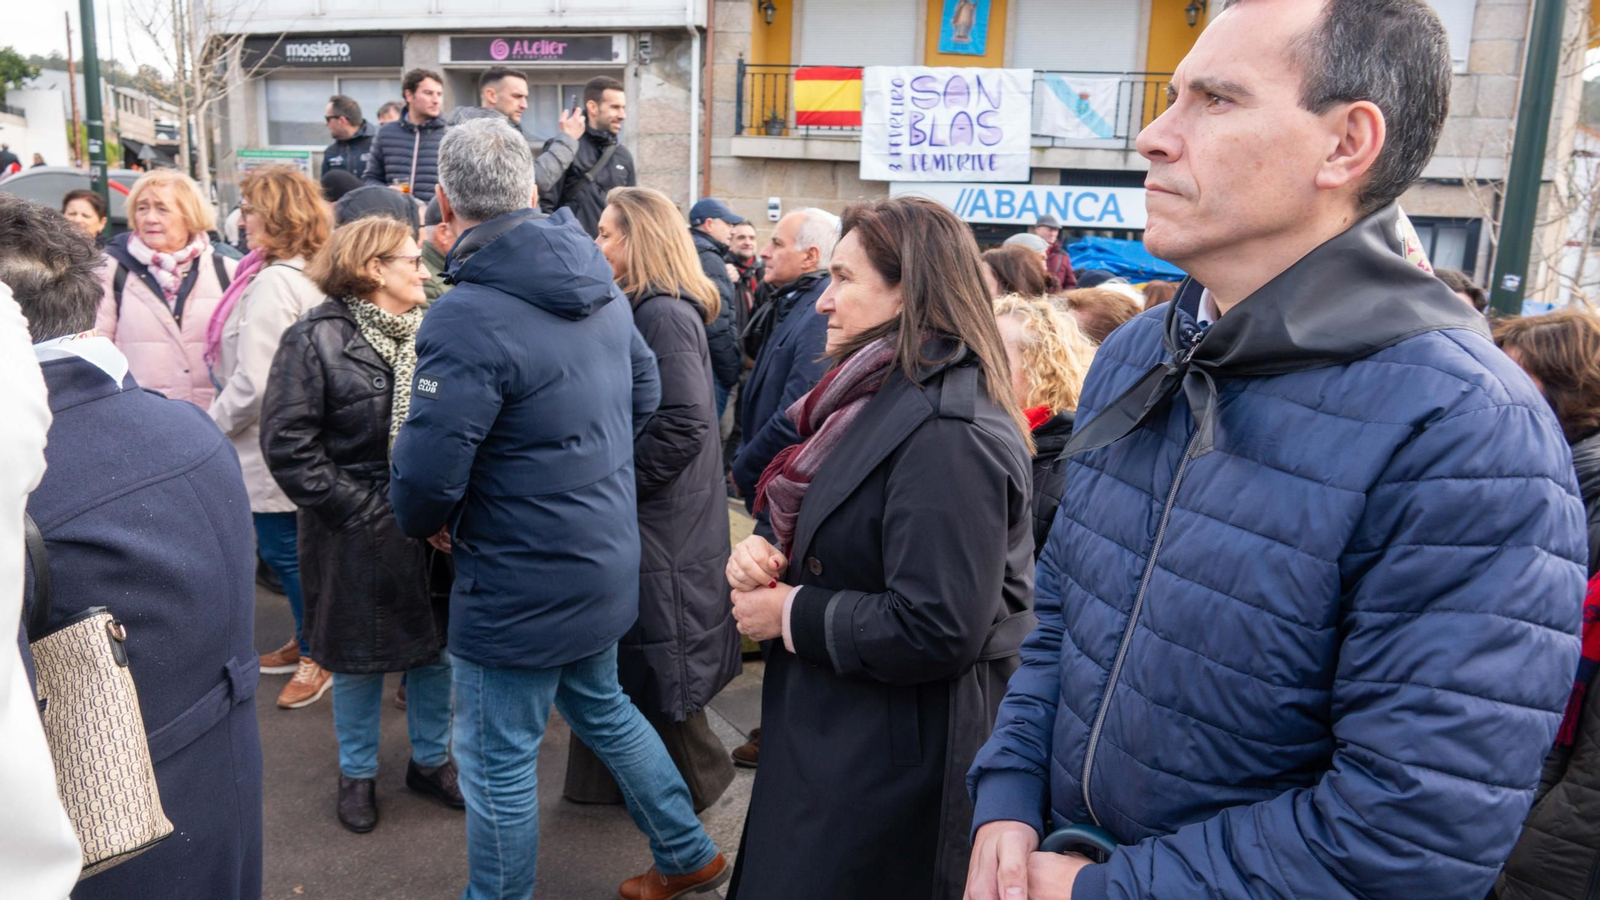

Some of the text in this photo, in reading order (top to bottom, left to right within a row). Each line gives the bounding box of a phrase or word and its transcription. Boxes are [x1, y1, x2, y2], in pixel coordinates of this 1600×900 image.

[285, 39, 351, 57] mosteiro
[910, 75, 1003, 110] SAN
[909, 110, 1003, 147] BLAS
[417, 384, 437, 393] CLUB
[419, 378, 438, 388] POLO
